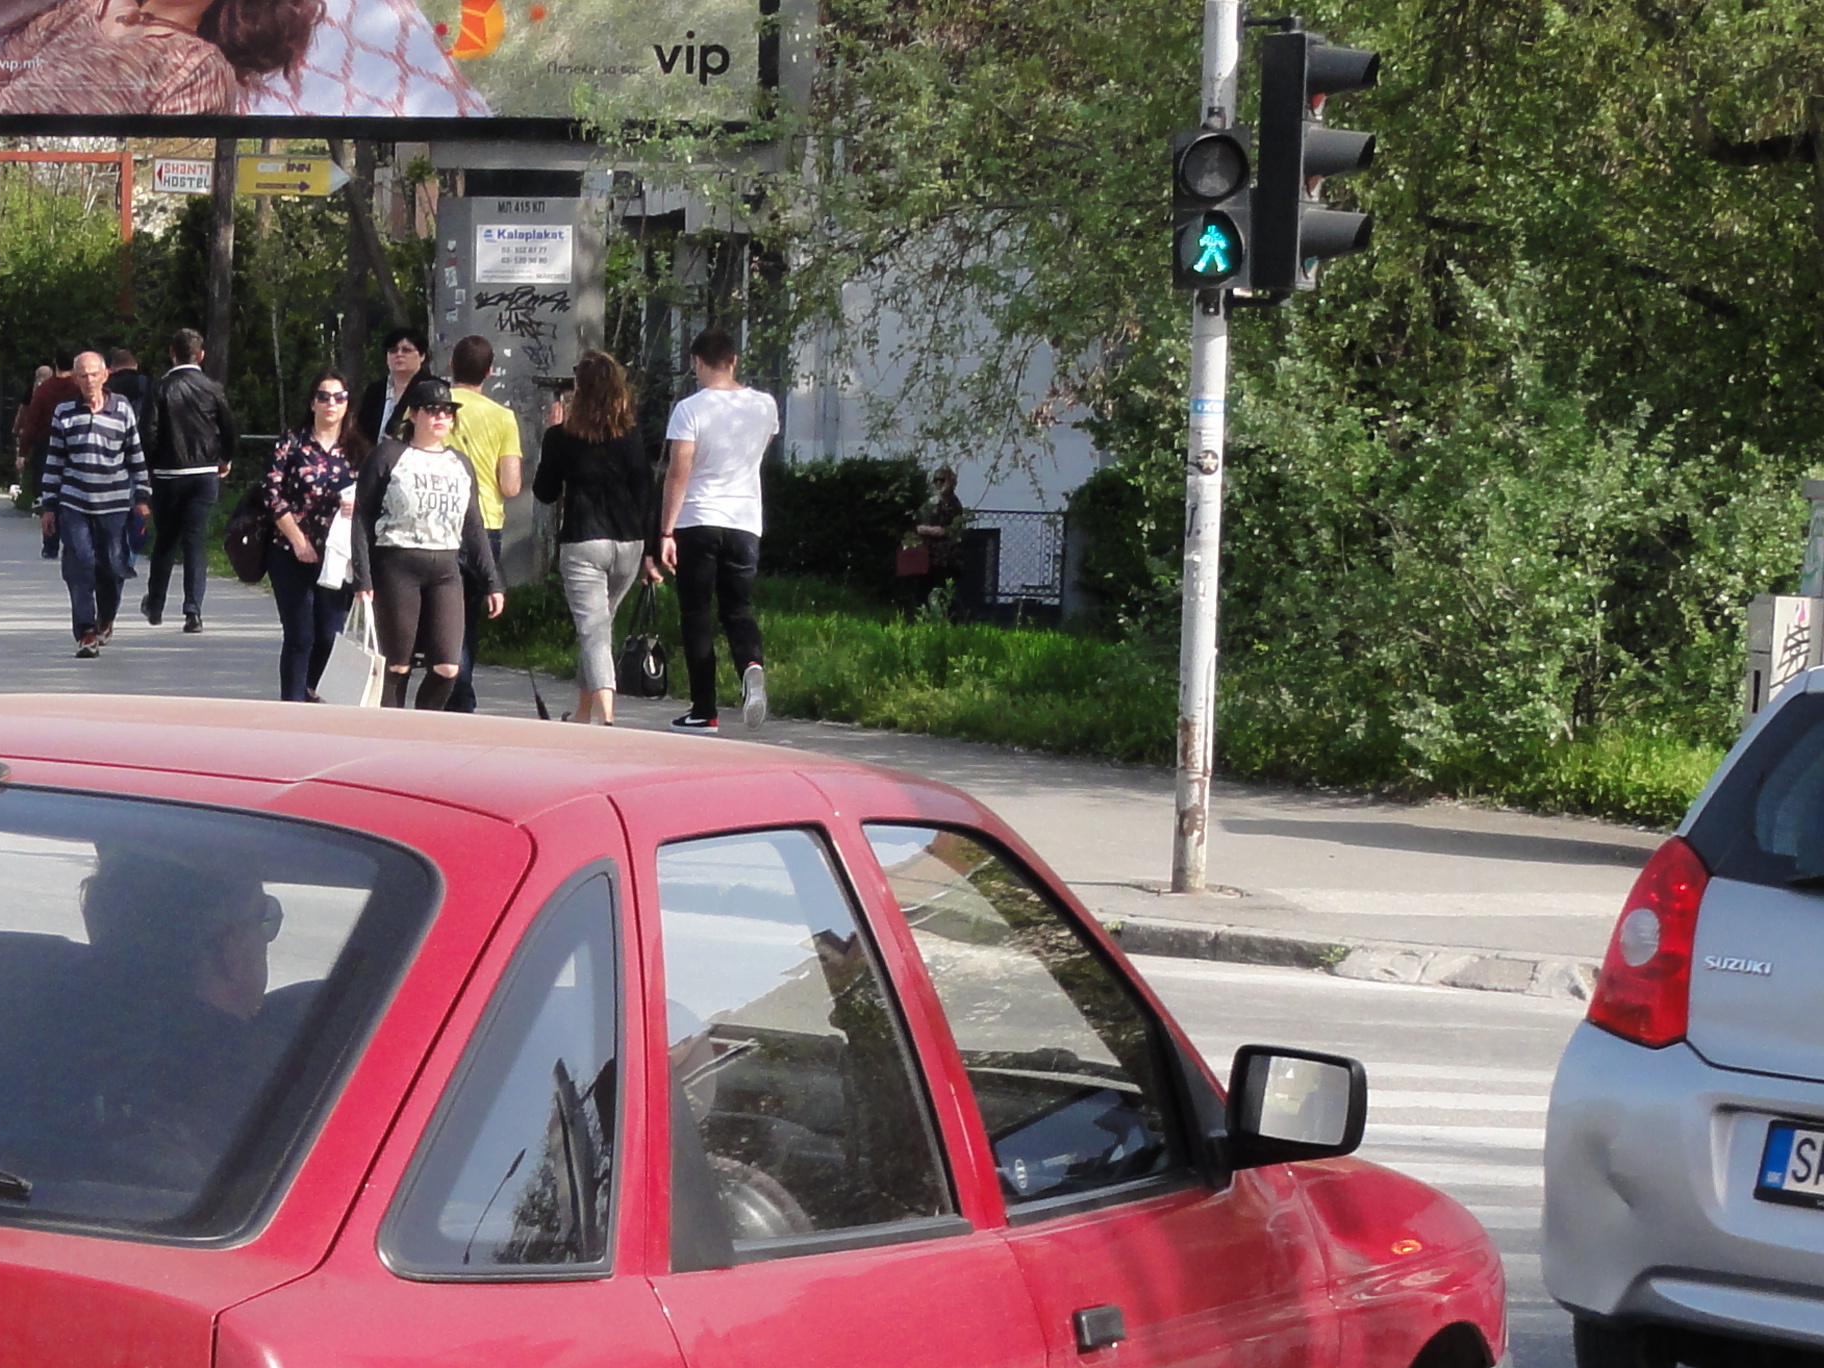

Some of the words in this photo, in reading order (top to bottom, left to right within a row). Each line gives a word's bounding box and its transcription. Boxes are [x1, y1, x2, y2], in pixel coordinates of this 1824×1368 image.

[653, 30, 731, 86] vip
[413, 472, 459, 494] NEW
[414, 491, 462, 514] YORK
[1703, 955, 1773, 975] SUZUKI
